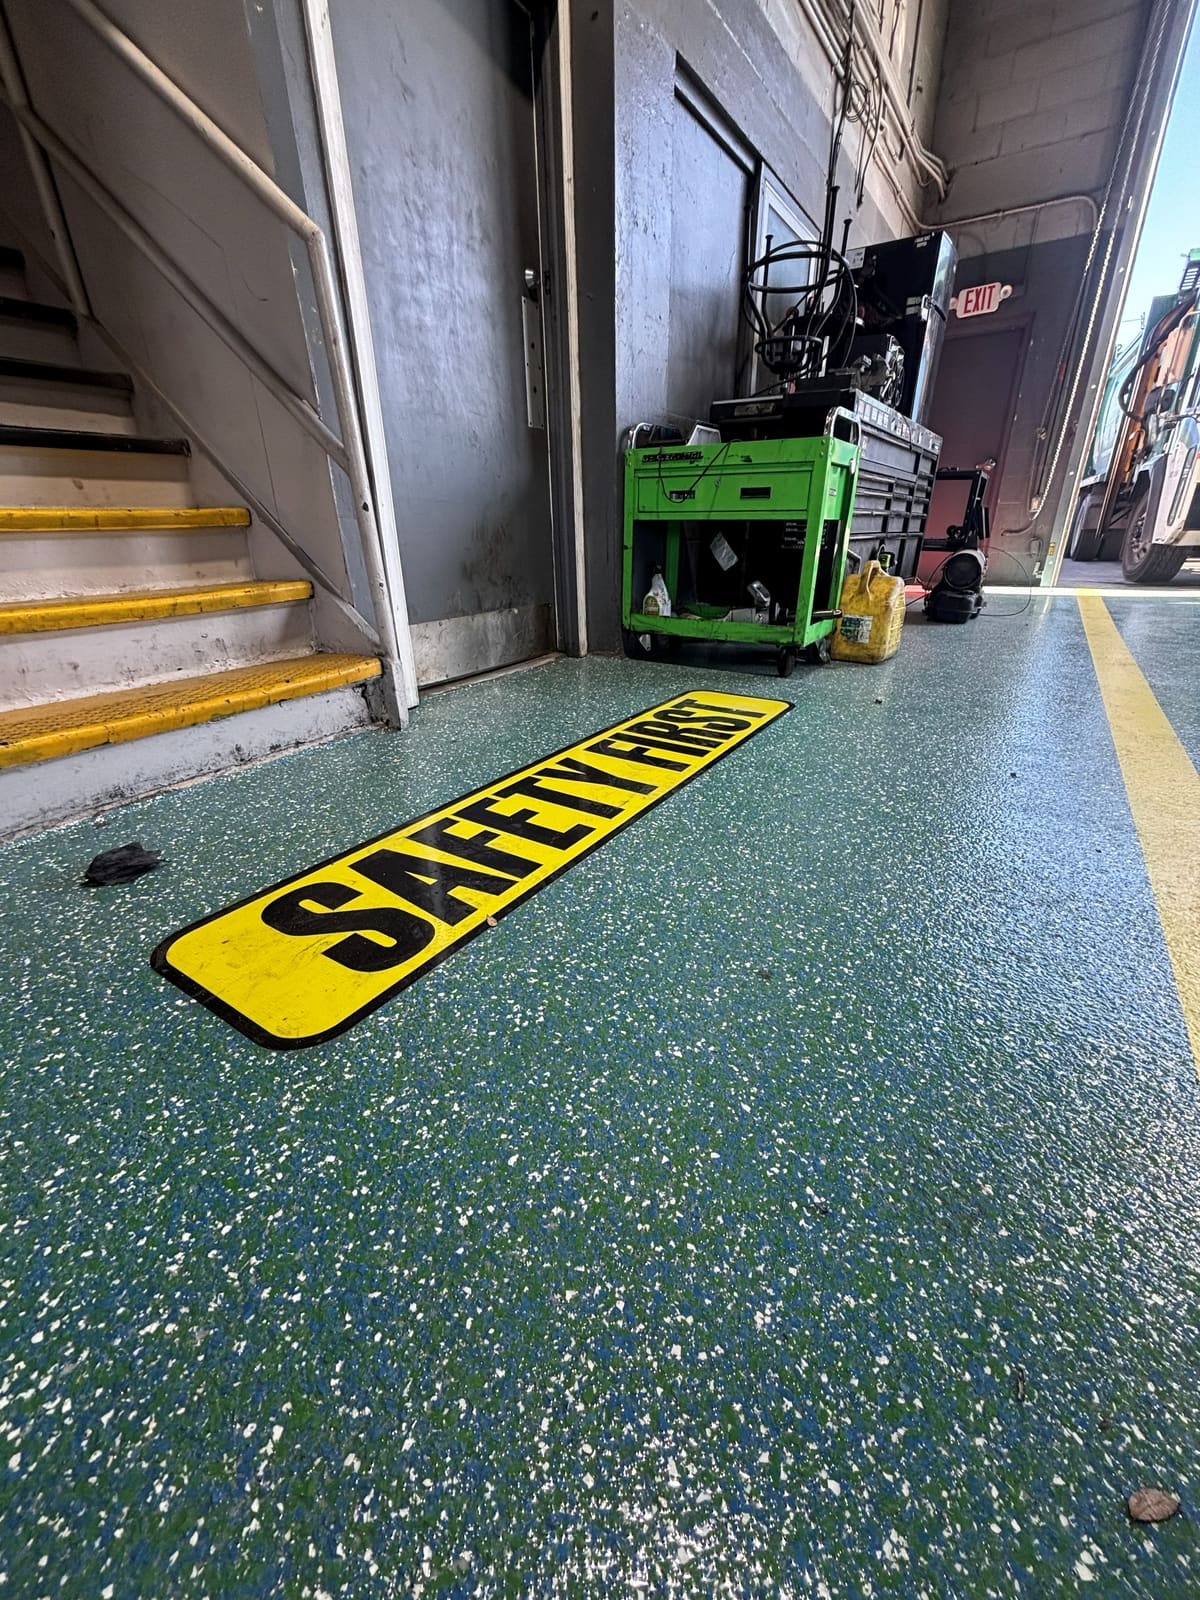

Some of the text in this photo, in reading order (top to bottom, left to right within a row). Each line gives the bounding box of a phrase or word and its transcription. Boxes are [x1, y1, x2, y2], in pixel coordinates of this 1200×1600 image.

[963, 285, 996, 314] EXIT
[261, 699, 767, 972] SAFETY FIRST
